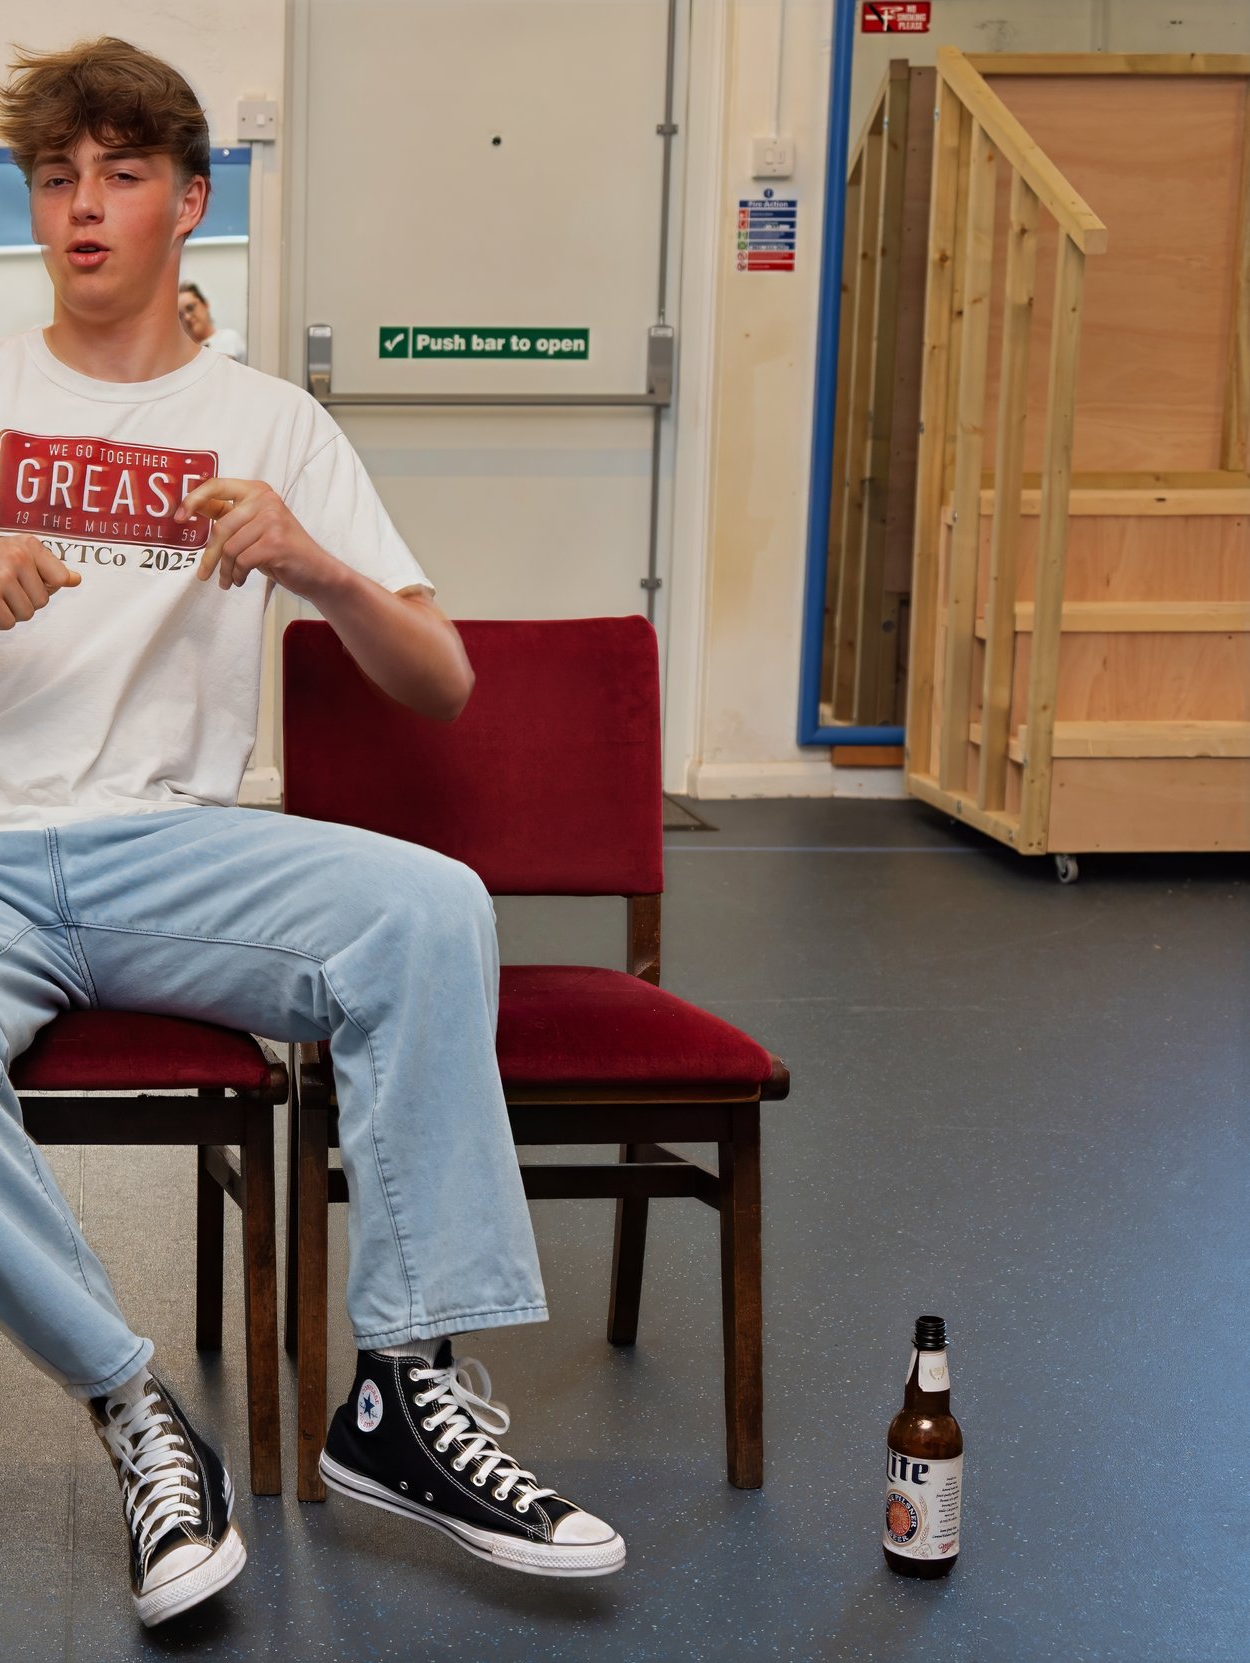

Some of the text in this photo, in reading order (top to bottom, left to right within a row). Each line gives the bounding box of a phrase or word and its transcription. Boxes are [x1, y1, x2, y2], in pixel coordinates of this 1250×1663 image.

[416, 334, 586, 355] Push bar to open
[49, 444, 168, 468] WE GO TOGETHER
[15, 511, 197, 543] 19 THE MUSICAL 59
[139, 548, 198, 571] 2025
